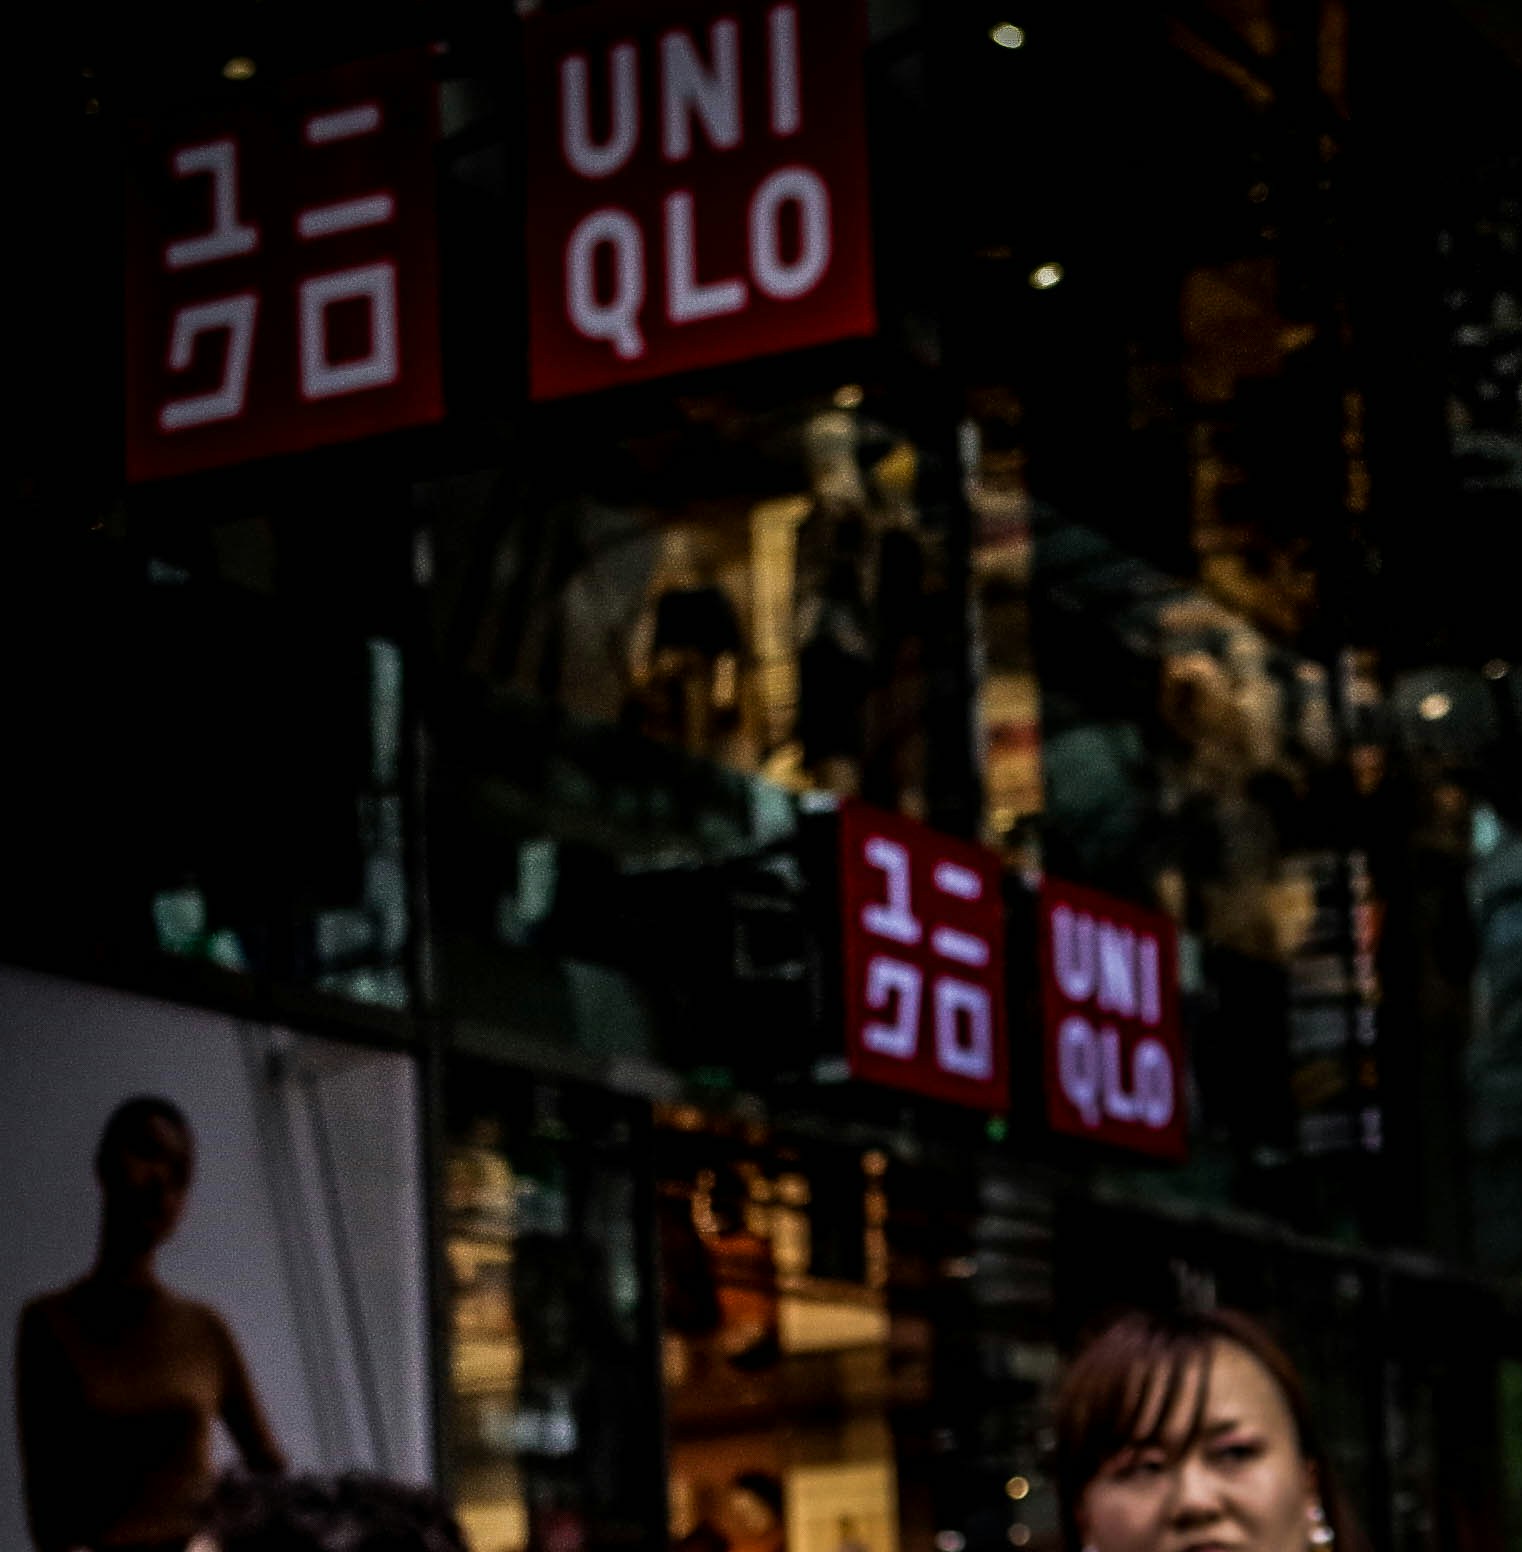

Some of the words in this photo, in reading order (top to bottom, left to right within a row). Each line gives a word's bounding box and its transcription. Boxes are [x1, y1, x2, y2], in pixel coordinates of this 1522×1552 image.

[560, 3, 804, 178] UNI
[565, 166, 833, 361] QLO
[1049, 904, 1162, 1027] UNI
[1056, 1012, 1176, 1129] QLO
